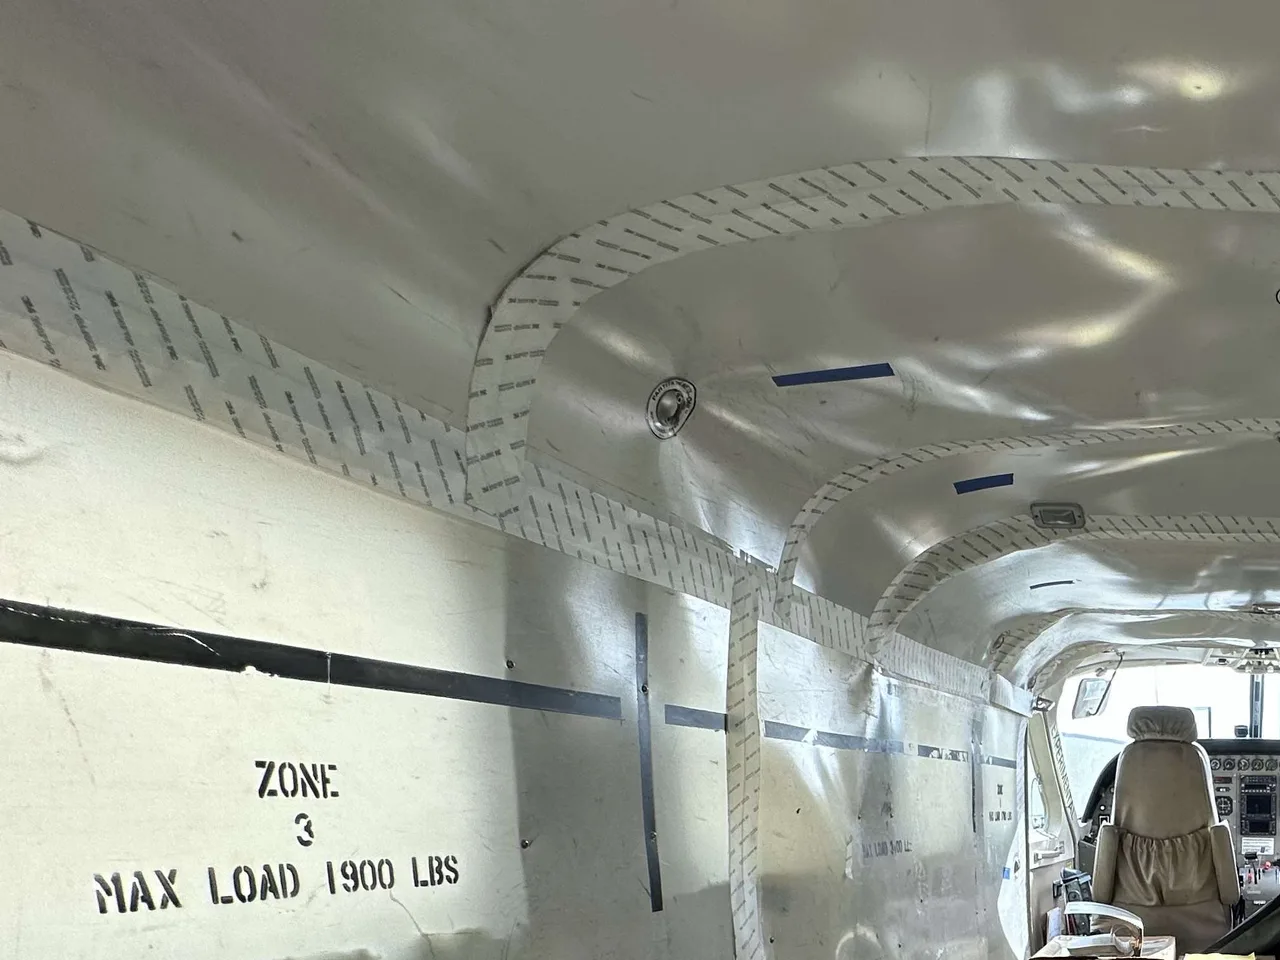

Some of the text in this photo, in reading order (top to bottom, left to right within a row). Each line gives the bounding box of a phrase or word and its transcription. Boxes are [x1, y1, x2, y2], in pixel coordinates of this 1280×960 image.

[255, 760, 340, 799] ZONE
[1050, 724, 1075, 820] EXPERIMENTAL
[295, 813, 315, 847] 3
[94, 856, 460, 914] MAX LOAD 1900 LBS
